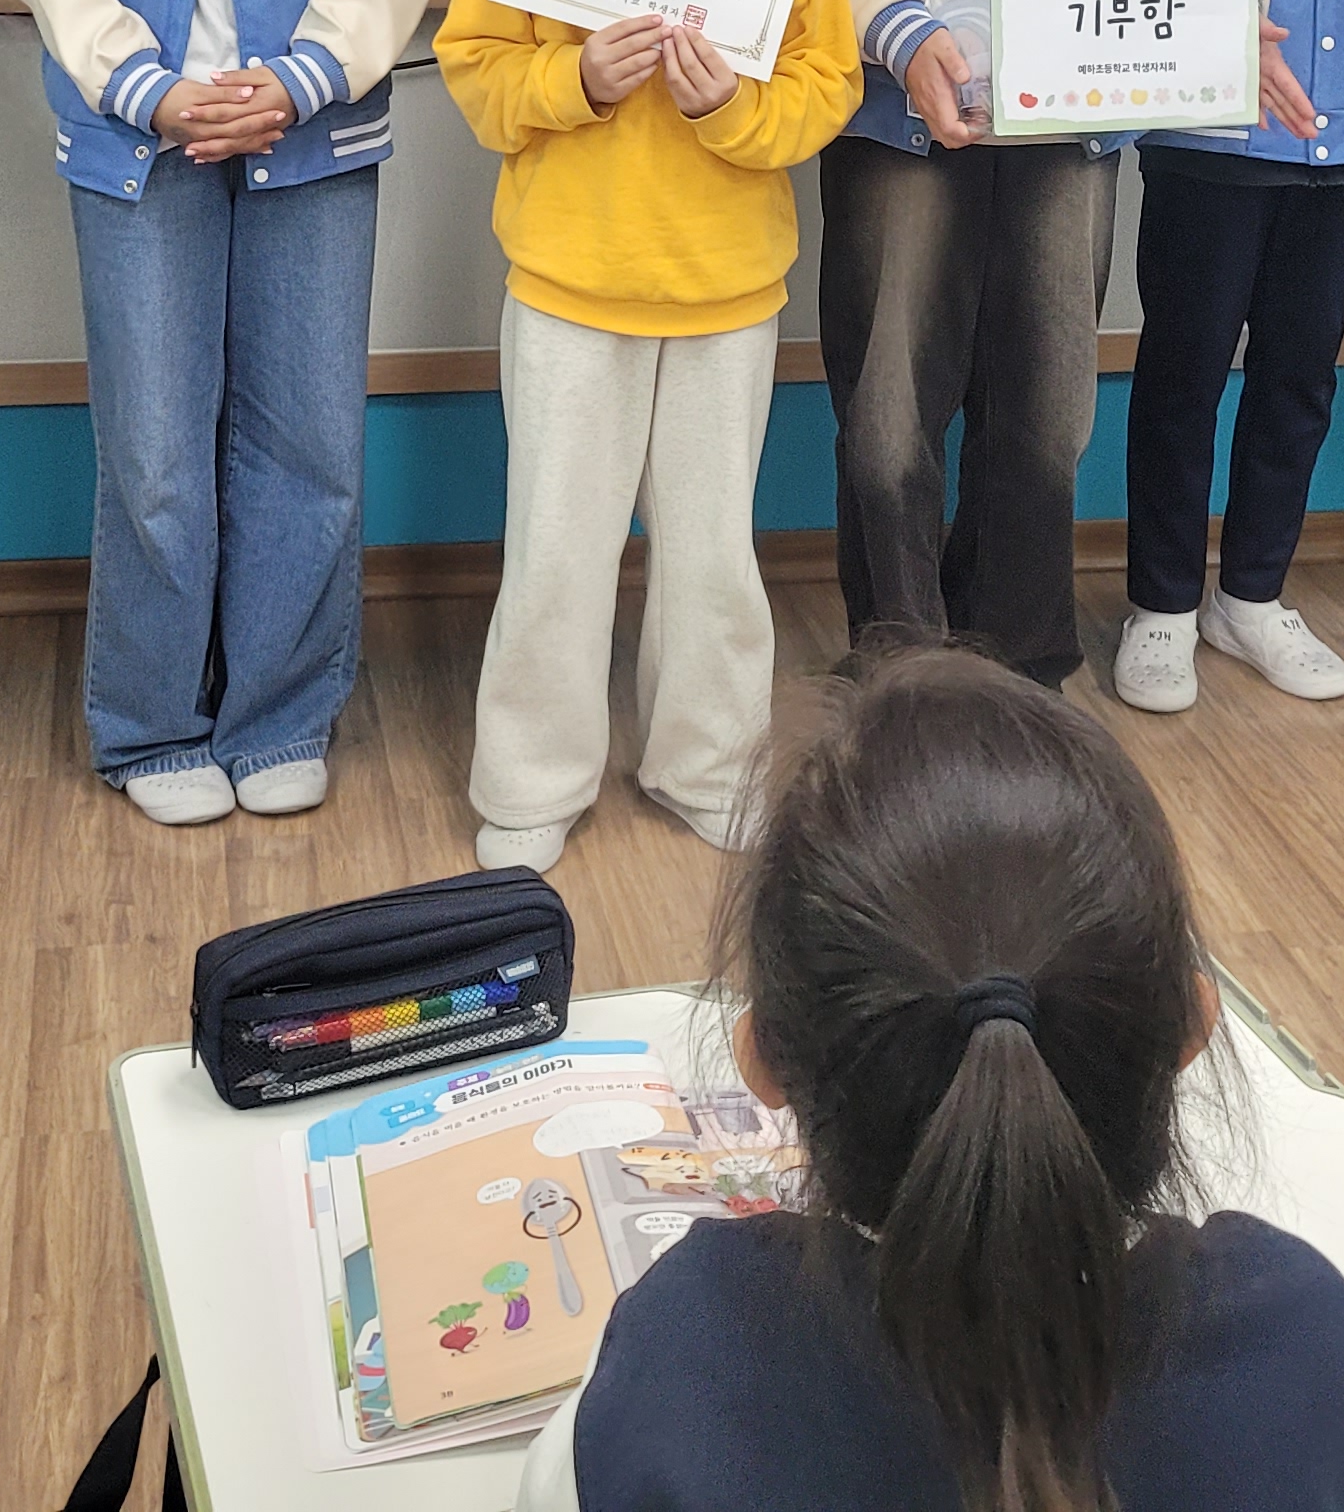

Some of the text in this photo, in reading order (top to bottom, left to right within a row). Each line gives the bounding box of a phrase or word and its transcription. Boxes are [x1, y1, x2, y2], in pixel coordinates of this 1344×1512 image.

[1077, 60, 1177, 75] 예하초등학교 학생자치회
[523, 1058, 574, 1081] 이야기
